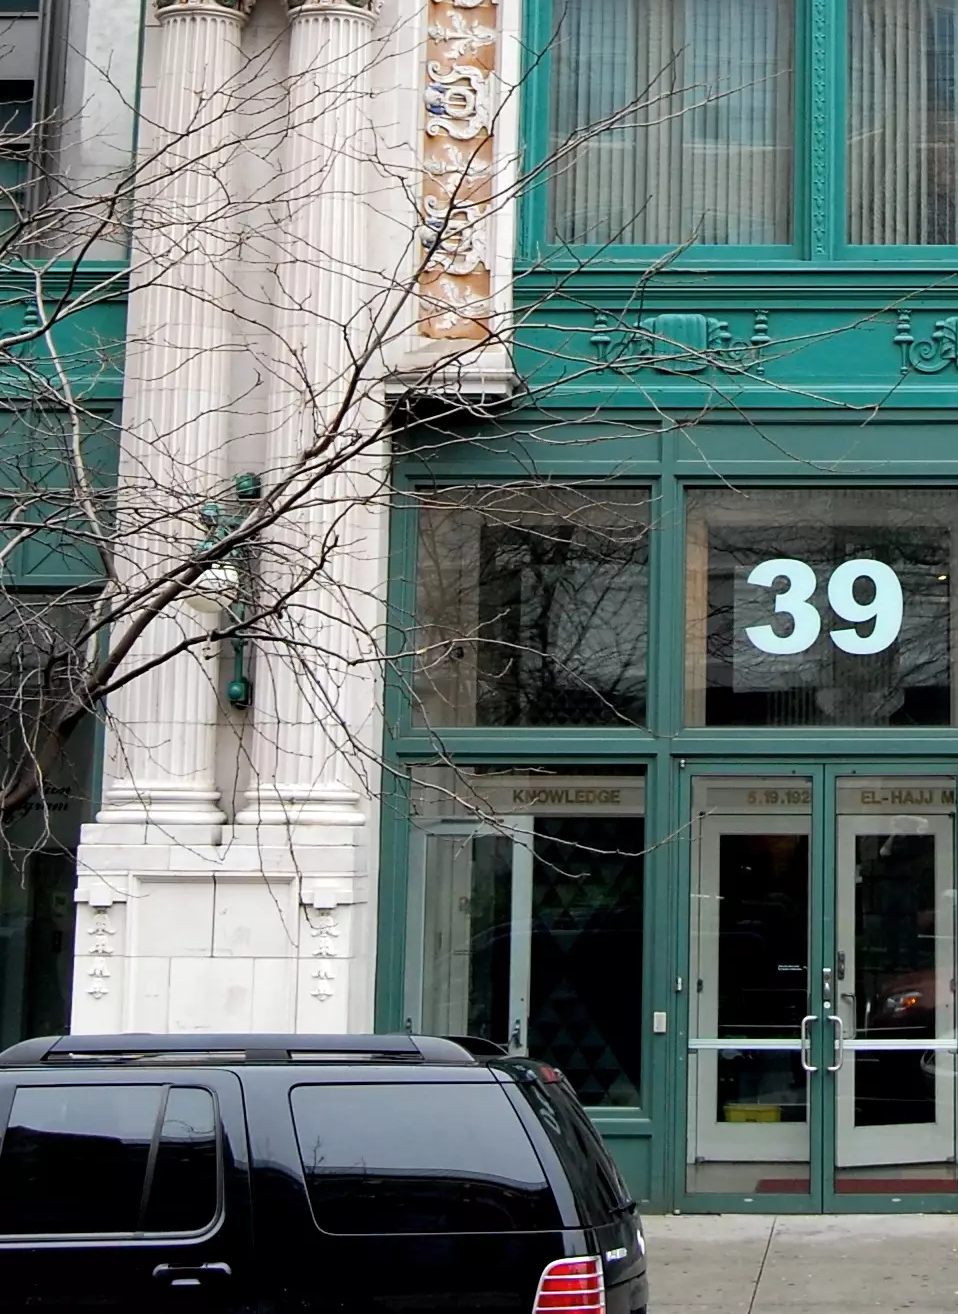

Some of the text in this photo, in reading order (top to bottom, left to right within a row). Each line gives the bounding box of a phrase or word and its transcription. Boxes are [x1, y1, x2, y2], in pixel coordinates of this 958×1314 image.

[744, 558, 904, 655] 39
[512, 789, 621, 804] KNOWLEDGE
[746, 790, 811, 805] 5.19.192
[860, 790, 934, 805] EL-HAJJ
